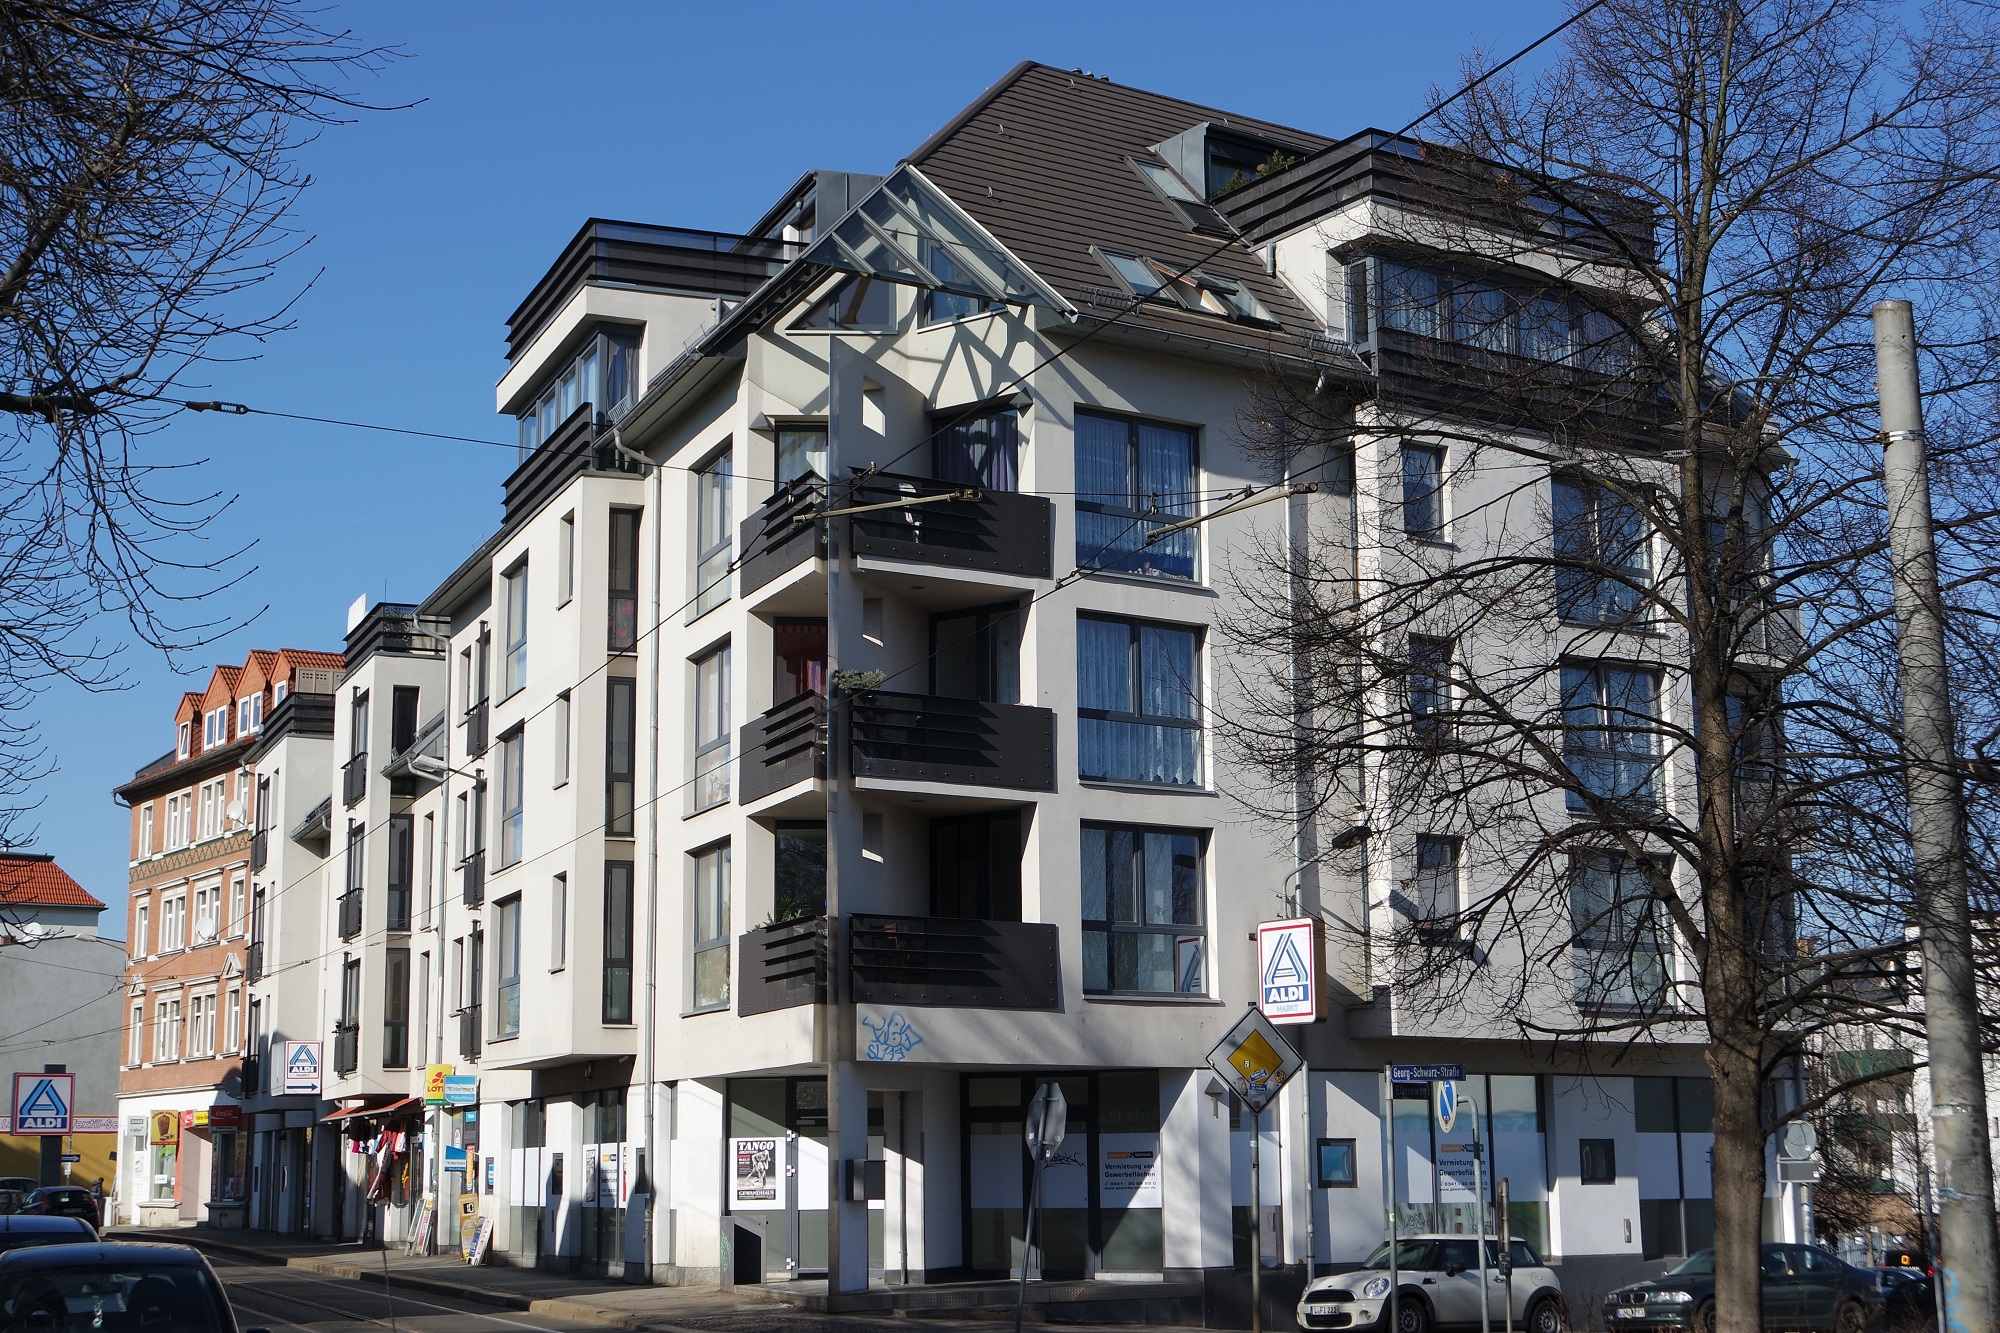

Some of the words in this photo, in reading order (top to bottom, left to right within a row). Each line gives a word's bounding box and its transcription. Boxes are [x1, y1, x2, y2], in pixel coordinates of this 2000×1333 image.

[1268, 986, 1304, 1003] ALDI
[1393, 1066, 1460, 1080] Georg-Schwarz-Straße
[23, 1117, 62, 1128] ALDI
[738, 1141, 775, 1151] TANGO
[1105, 1163, 1142, 1171] Vermietung
[1439, 1159, 1475, 1167] Vermietung
